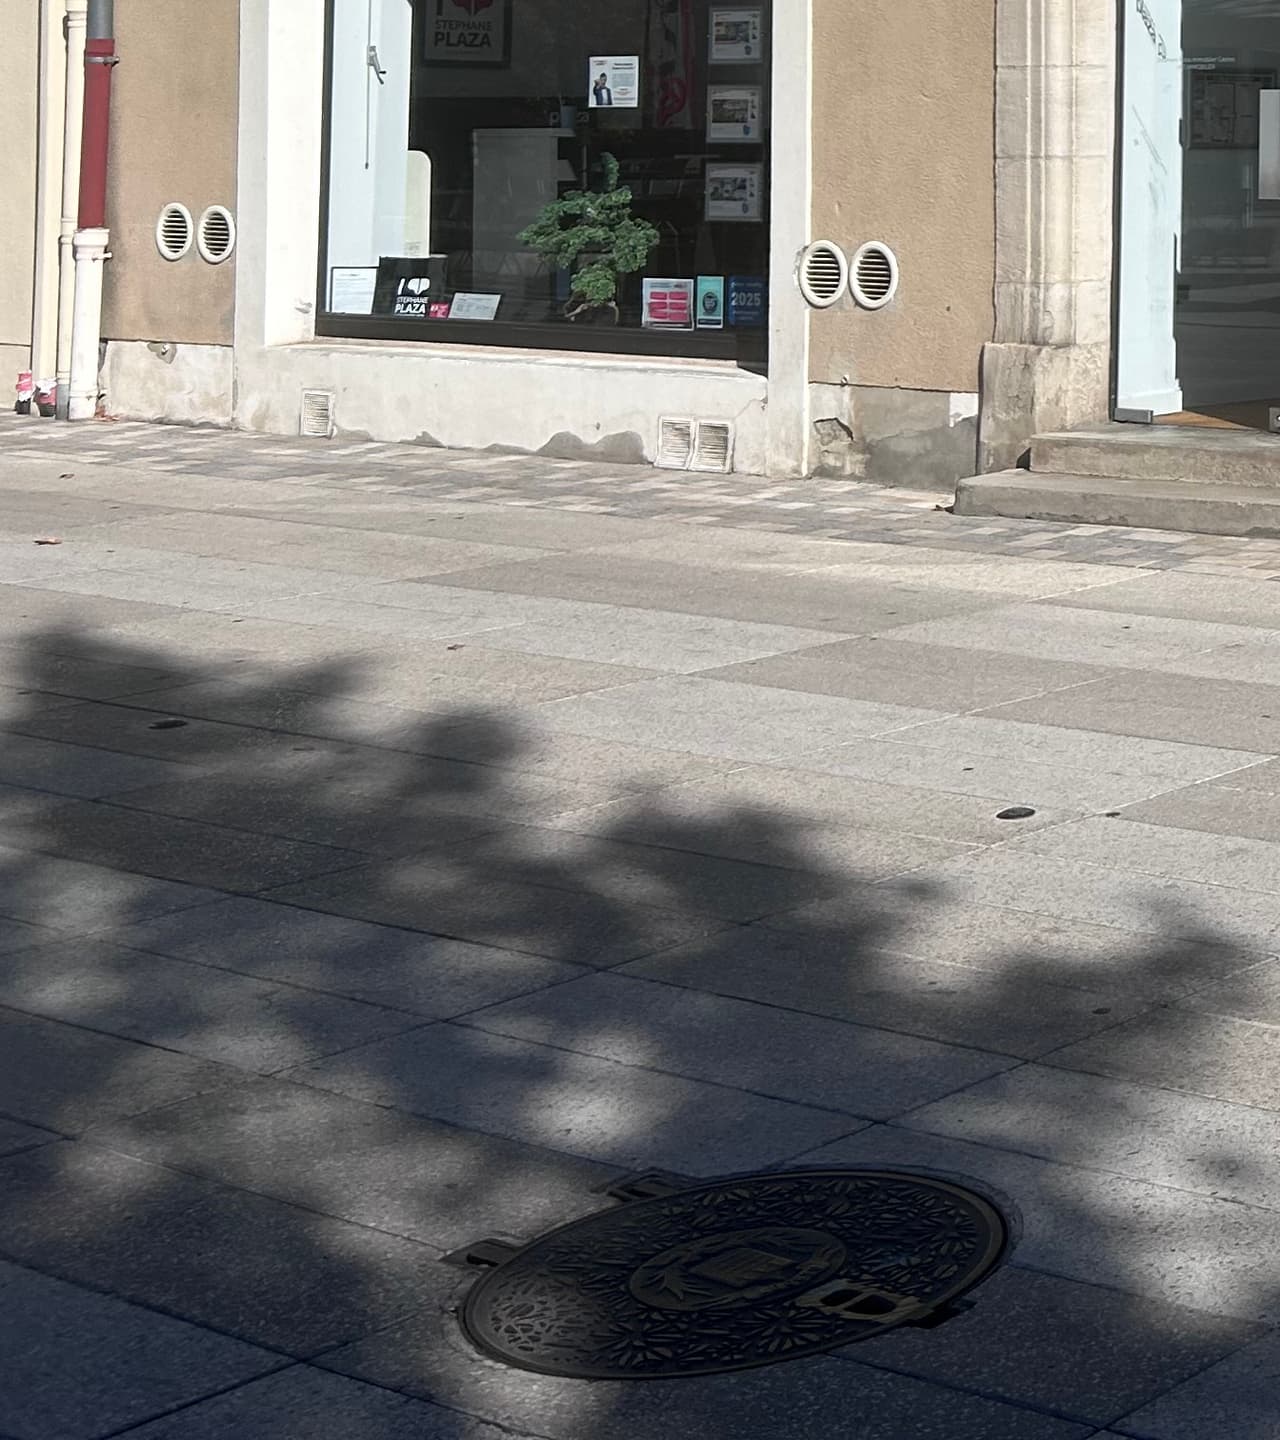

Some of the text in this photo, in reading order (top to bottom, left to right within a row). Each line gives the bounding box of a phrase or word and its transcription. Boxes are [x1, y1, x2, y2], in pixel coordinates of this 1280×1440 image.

[435, 19, 493, 31] STEPHANE
[434, 31, 491, 48] PLAZA
[731, 291, 761, 306] 2025
[394, 303, 426, 314] PLAZA
